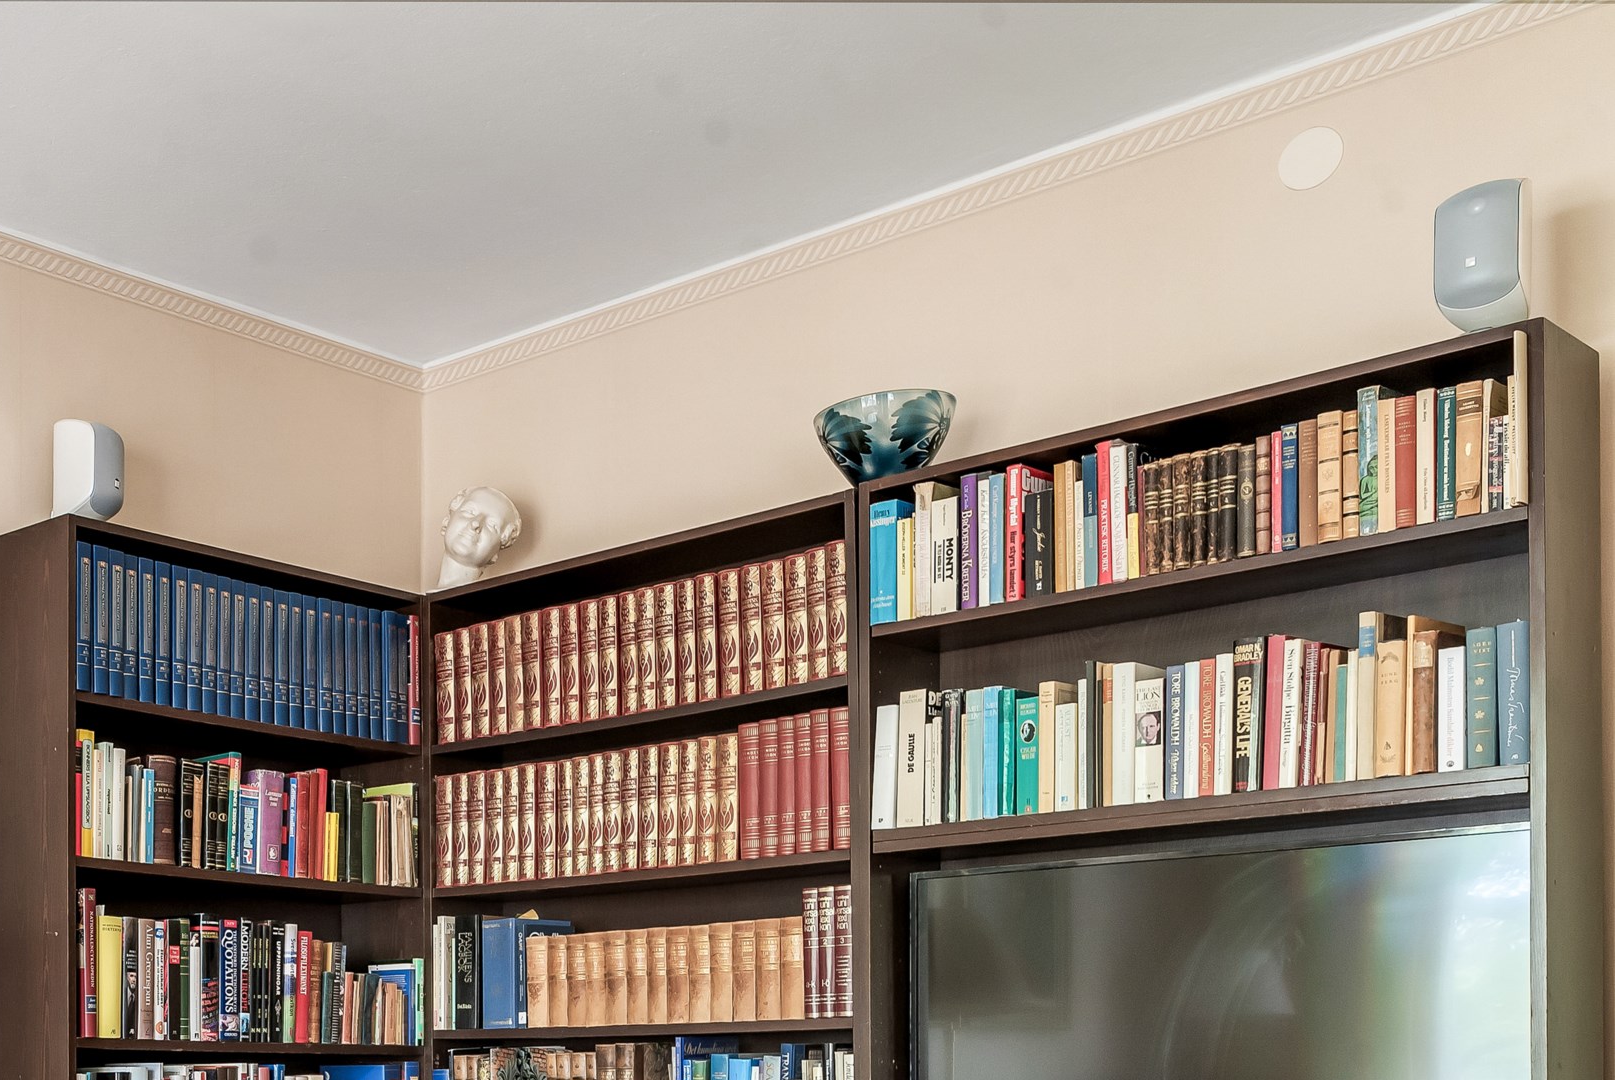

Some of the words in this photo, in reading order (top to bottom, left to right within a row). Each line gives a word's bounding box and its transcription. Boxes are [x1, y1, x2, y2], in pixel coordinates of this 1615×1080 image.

[961, 510, 973, 557] BRÖDERNA
[1100, 499, 1108, 537] PRAKTISK
[1009, 530, 1017, 543] Hur
[945, 537, 954, 580] MONTY
[1009, 545, 1017, 567] styrs
[1101, 539, 1109, 573] RETORIK
[961, 556, 973, 601] KREUGER
[1008, 569, 1017, 593] landet
[1234, 644, 1253, 655] OMAR
[1234, 650, 1263, 662] BRADLEY
[1287, 649, 1295, 671] Sven
[1171, 672, 1181, 695] TORE
[1203, 664, 1212, 688] TORE
[1285, 672, 1295, 704] Stolpe
[1446, 675, 1454, 707] Malmsten
[1136, 691, 1161, 702] LION
[1170, 697, 1181, 746] BROWALDH
[1202, 690, 1212, 739] BROWALDH
[1283, 705, 1296, 744] Birgitta
[908, 733, 916, 762] GAULLE
[1236, 737, 1250, 759] LIFE
[908, 763, 915, 773] DE
[243, 806, 255, 849] POCHE
[145, 924, 154, 949] Alan
[241, 924, 249, 971] MODERN
[458, 932, 467, 973] LAGBOK
[142, 955, 153, 1006] Greenspan
[221, 929, 234, 1014] QUOTATIONS
[240, 971, 249, 1012] EUROPE
